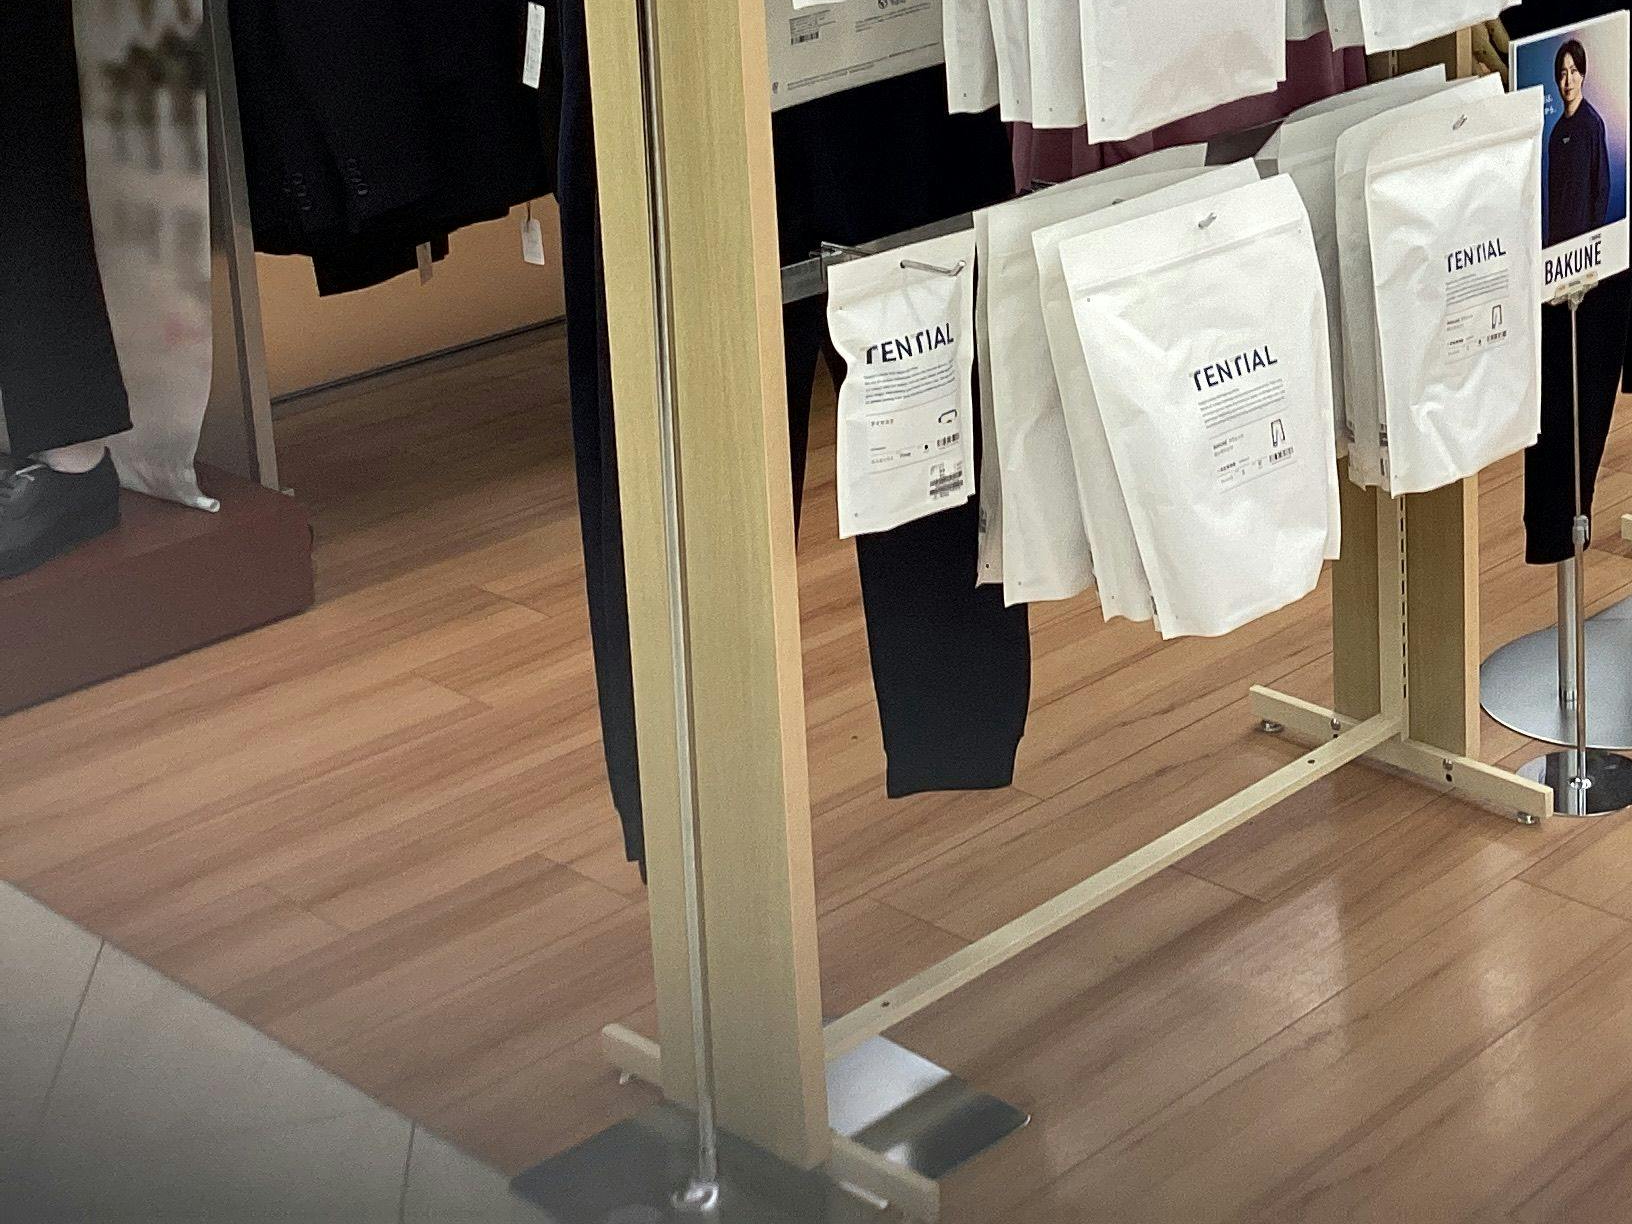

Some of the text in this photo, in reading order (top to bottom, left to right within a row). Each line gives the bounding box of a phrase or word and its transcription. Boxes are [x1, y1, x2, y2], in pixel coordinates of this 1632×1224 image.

[1446, 237, 1507, 273] TENTIAL
[1544, 240, 1602, 287] BAKUNE
[863, 322, 955, 365] TENTIAL
[1191, 345, 1278, 392] TENTIAL
